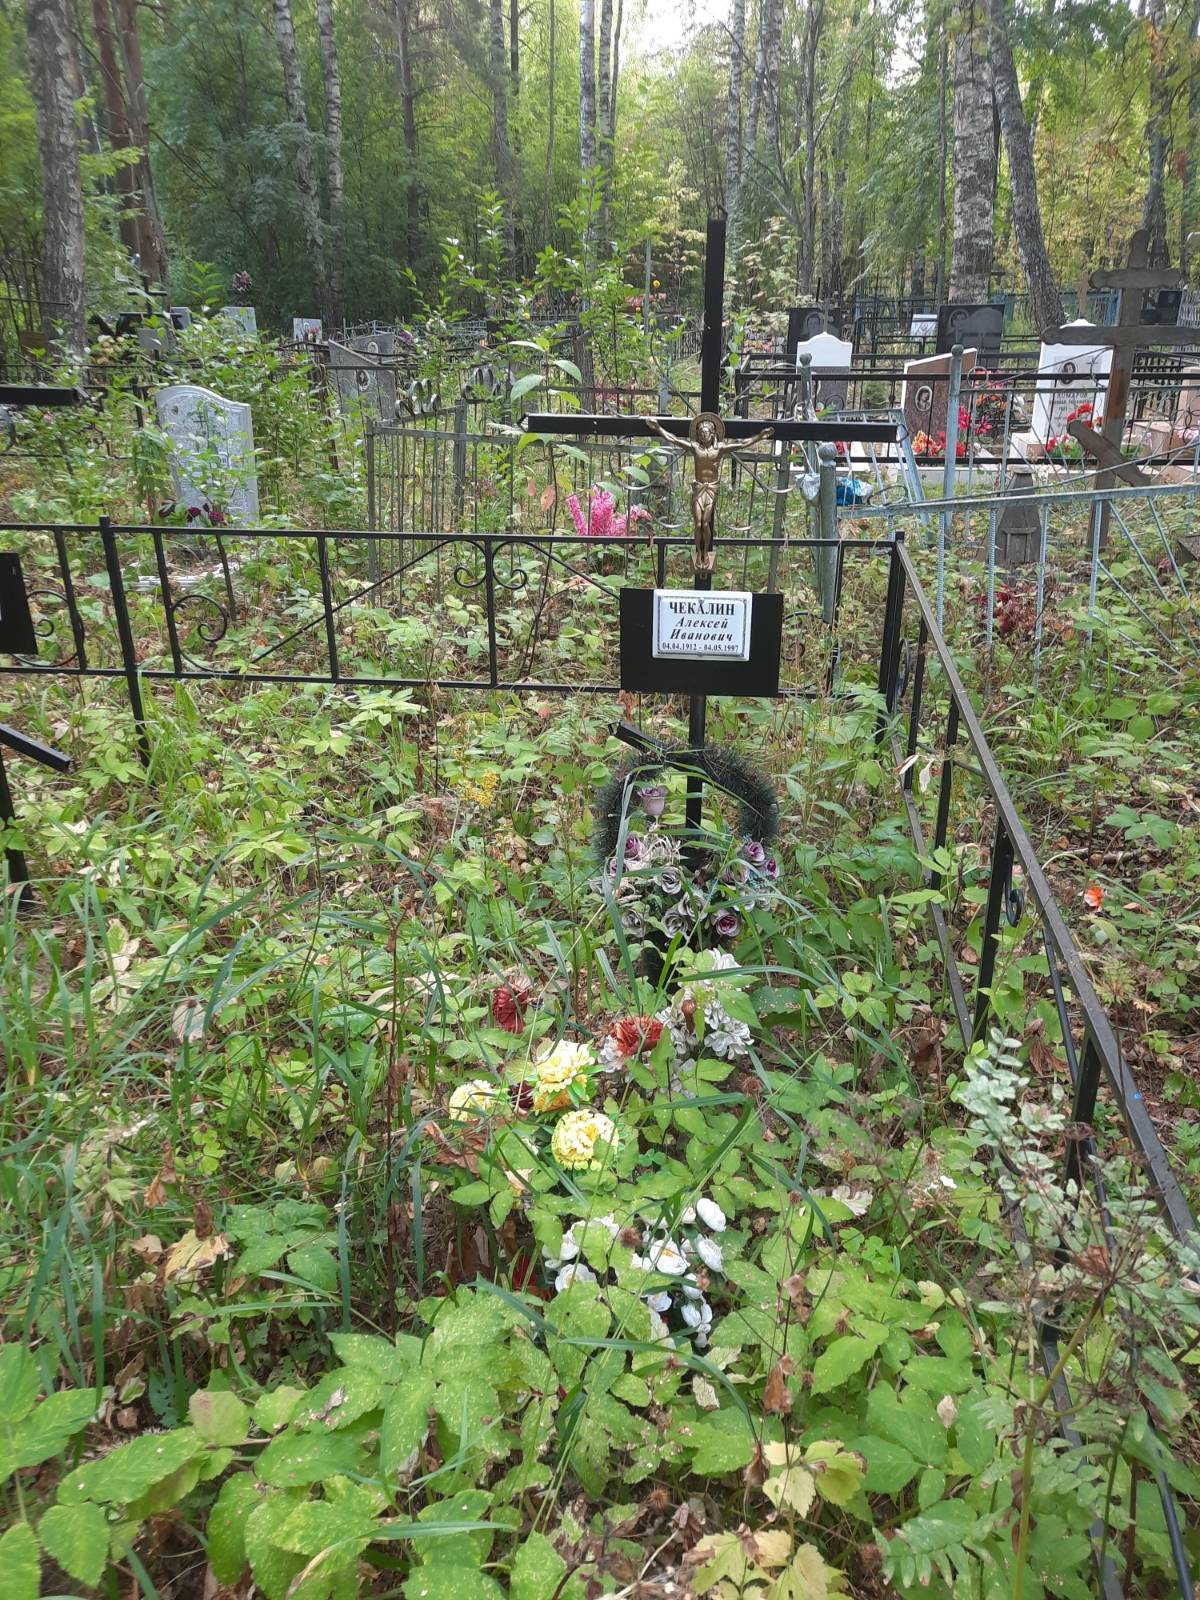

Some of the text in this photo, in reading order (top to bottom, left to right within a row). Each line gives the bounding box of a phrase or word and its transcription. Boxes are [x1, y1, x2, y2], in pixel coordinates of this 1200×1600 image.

[669, 601, 735, 615] ЧЕКАЛИН
[675, 616, 728, 629] Алексей
[670, 628, 733, 641] Иванович
[662, 642, 697, 651] 04.04.1912
[703, 644, 739, 652] 04.05.1997
